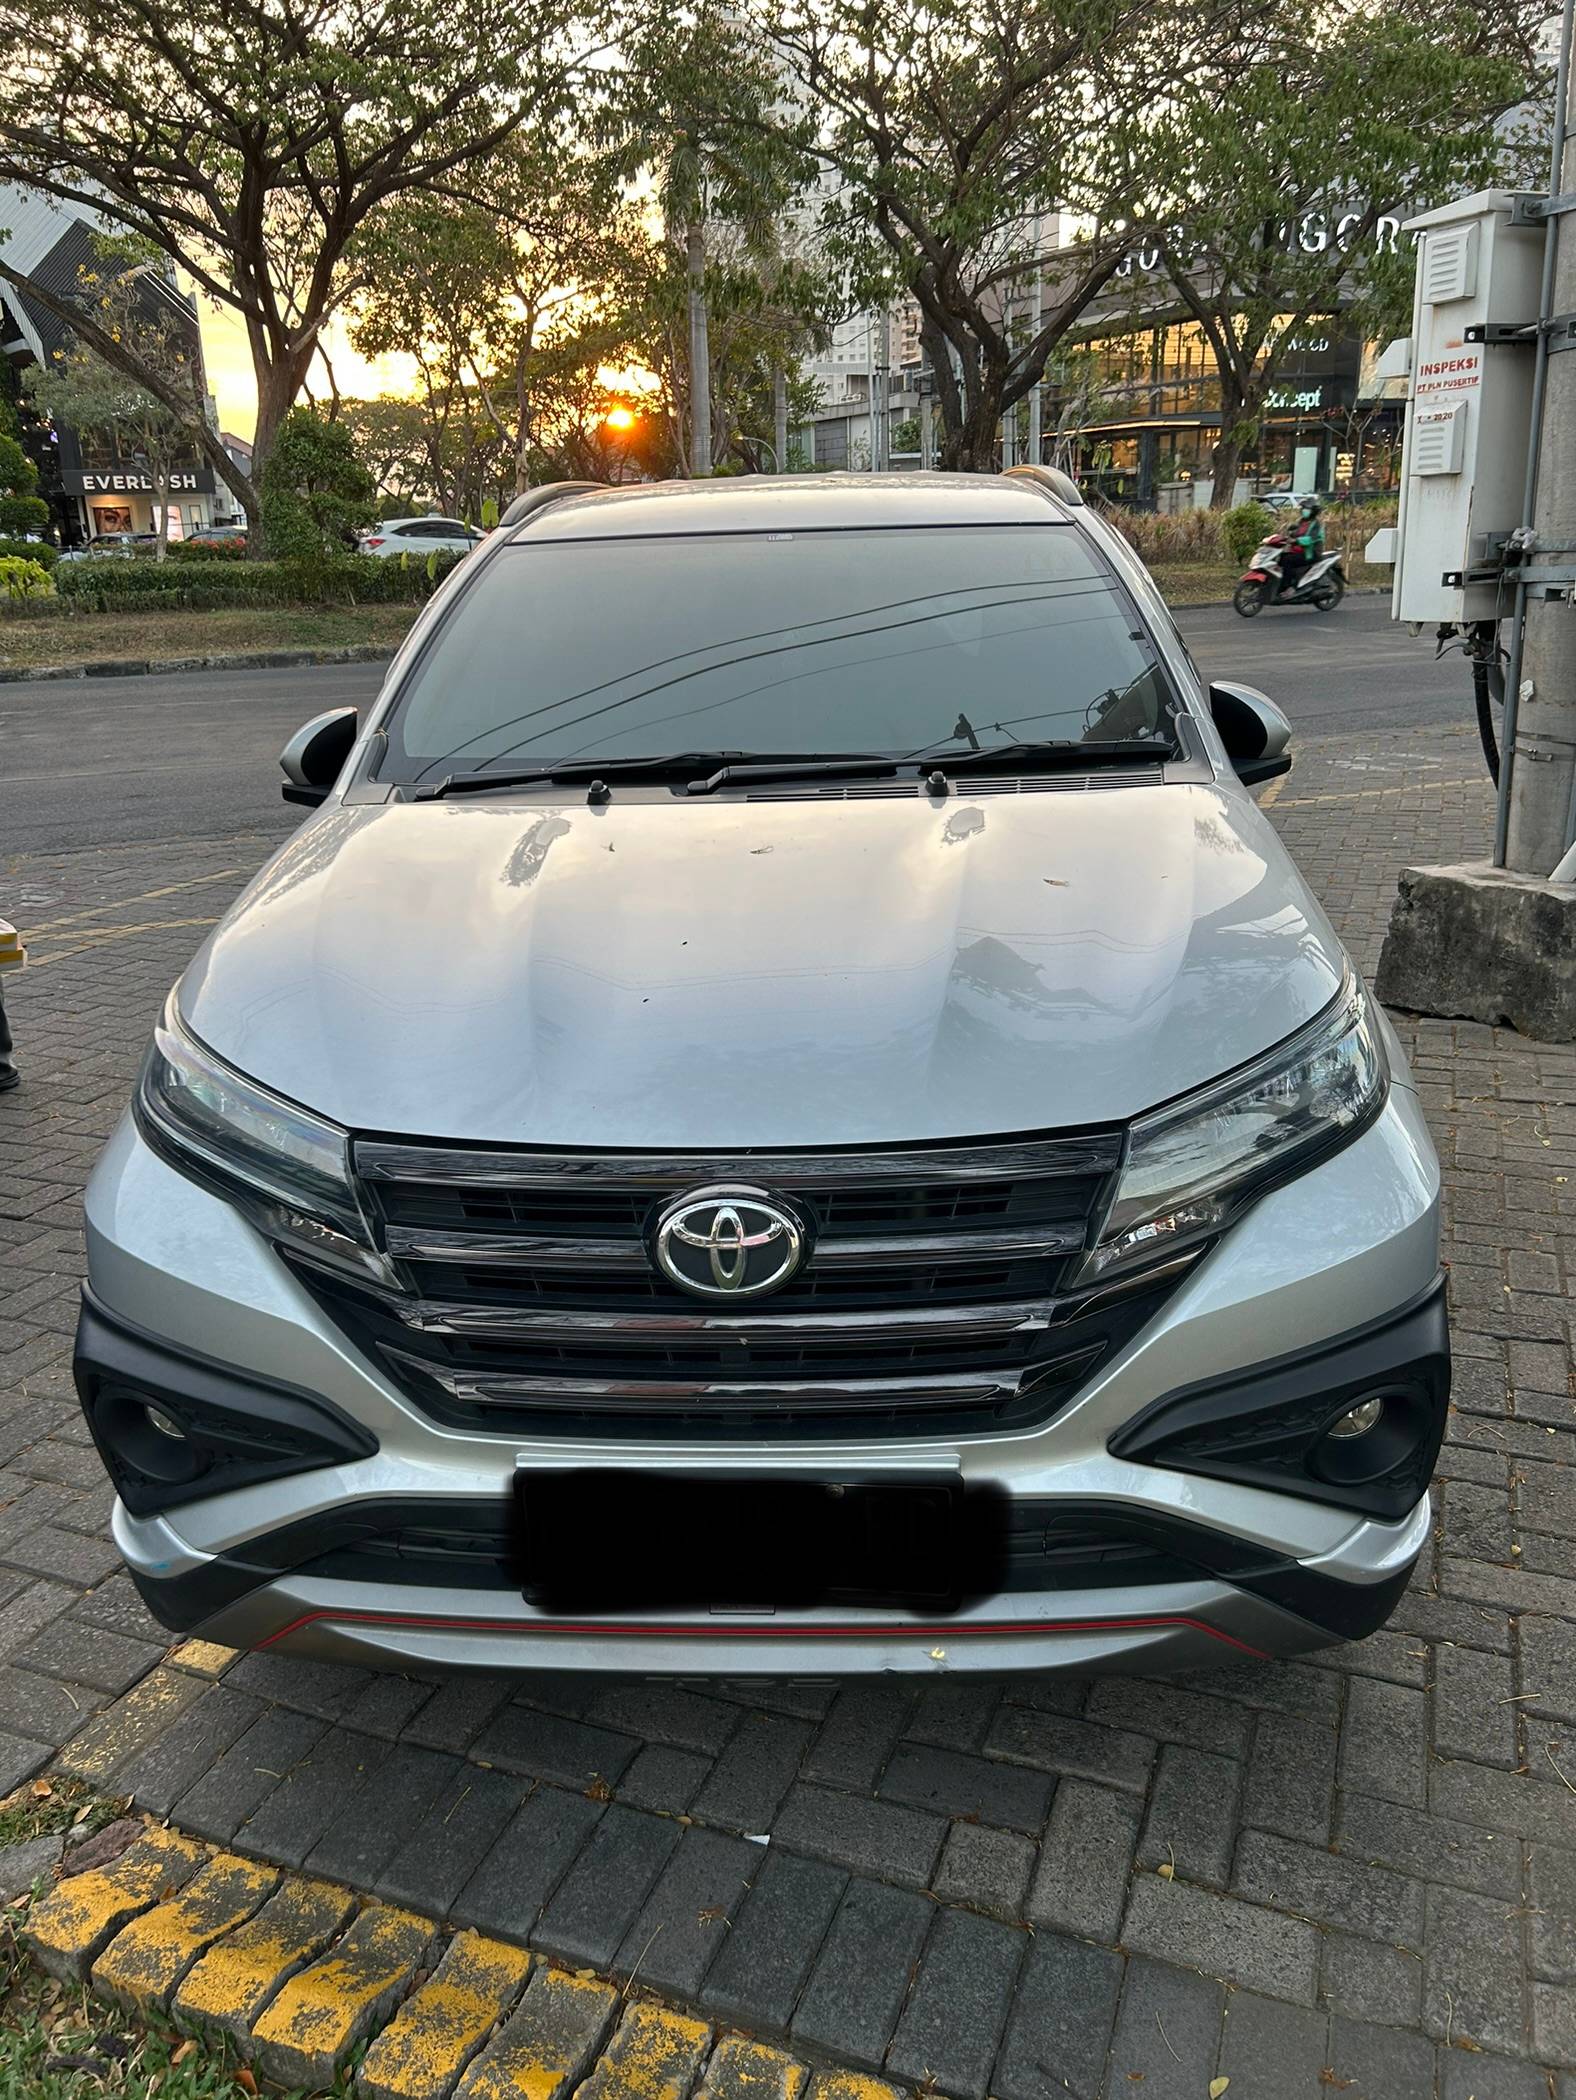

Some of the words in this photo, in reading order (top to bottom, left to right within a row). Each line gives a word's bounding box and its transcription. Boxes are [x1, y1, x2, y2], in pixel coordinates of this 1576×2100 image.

[1420, 357, 1478, 376] INSPEKSI
[1417, 384, 1426, 392] PT
[1428, 381, 1442, 390] PLN
[82, 475, 197, 490] EVERLSH
